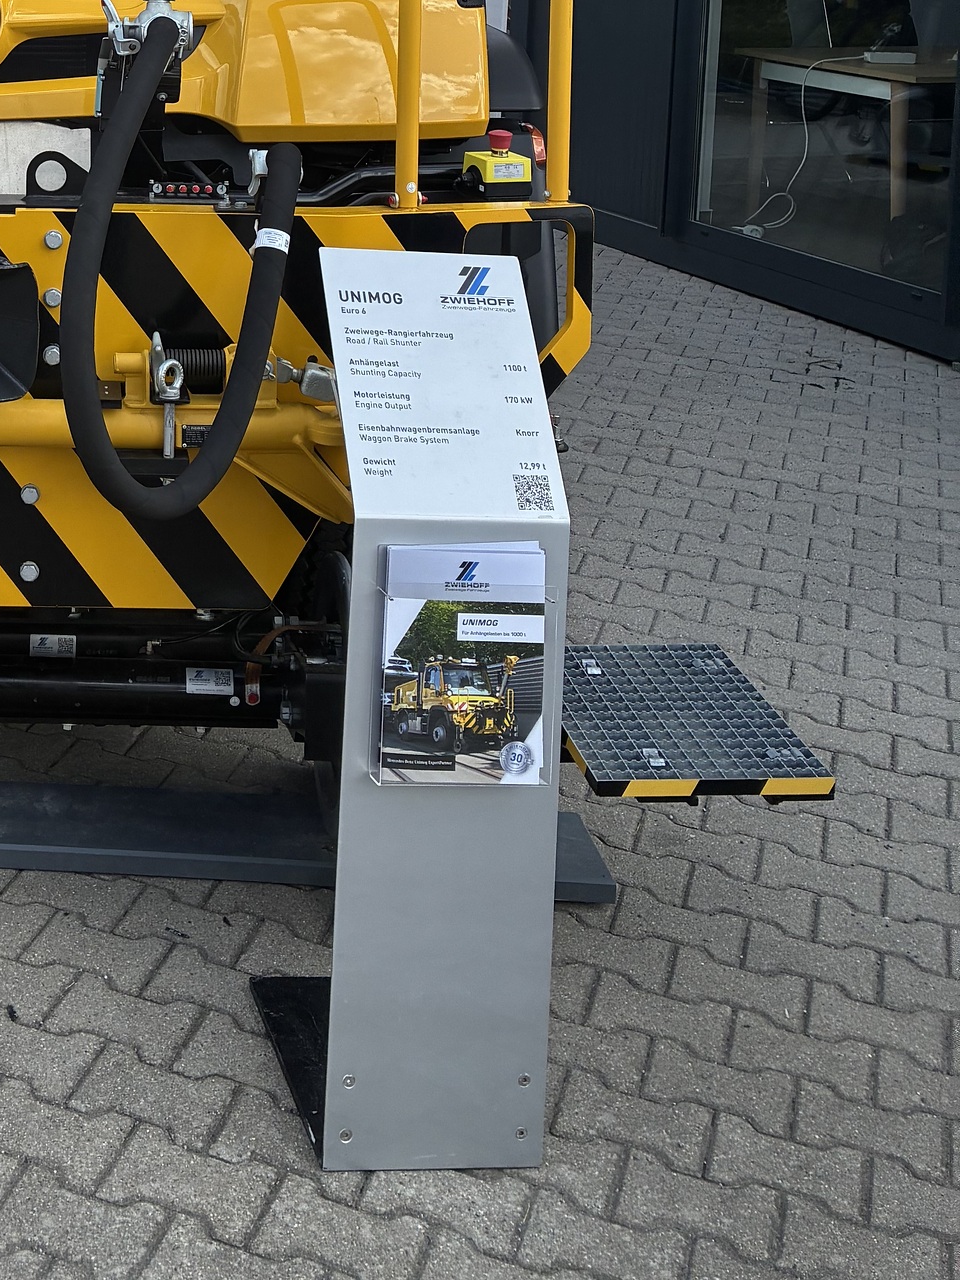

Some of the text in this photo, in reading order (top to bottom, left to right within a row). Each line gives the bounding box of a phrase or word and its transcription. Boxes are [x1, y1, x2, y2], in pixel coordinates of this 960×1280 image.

[338, 289, 404, 305] UNIMOG
[440, 296, 515, 307] ZWIEHOFF
[340, 306, 367, 315] Euro 6
[441, 304, 517, 313] Zweiwege-Fahrzeuge
[344, 327, 454, 341] Zweiwege-Rangierfahrzeug
[346, 337, 365, 346] Road
[373, 337, 389, 346] Rail
[390, 338, 422, 347] Shunter
[349, 358, 400, 368] Anhängelast
[503, 364, 523, 372] 1100
[350, 368, 422, 380] Shunting Capacity
[353, 390, 411, 402] Motorleistung
[504, 396, 533, 405] 170 kW
[355, 401, 412, 412] Engine Output
[358, 423, 481, 436] Eisenbahnwagenbremsanlage
[515, 429, 540, 437] Knorr
[359, 434, 450, 445] Waggon Brake System
[362, 457, 396, 467] Gewicht
[519, 462, 542, 471] 12,99
[364, 467, 393, 477] Weight
[444, 581, 490, 589] ZWIEHOFF
[462, 619, 499, 627] UNIMOG
[510, 752, 523, 763] 30
